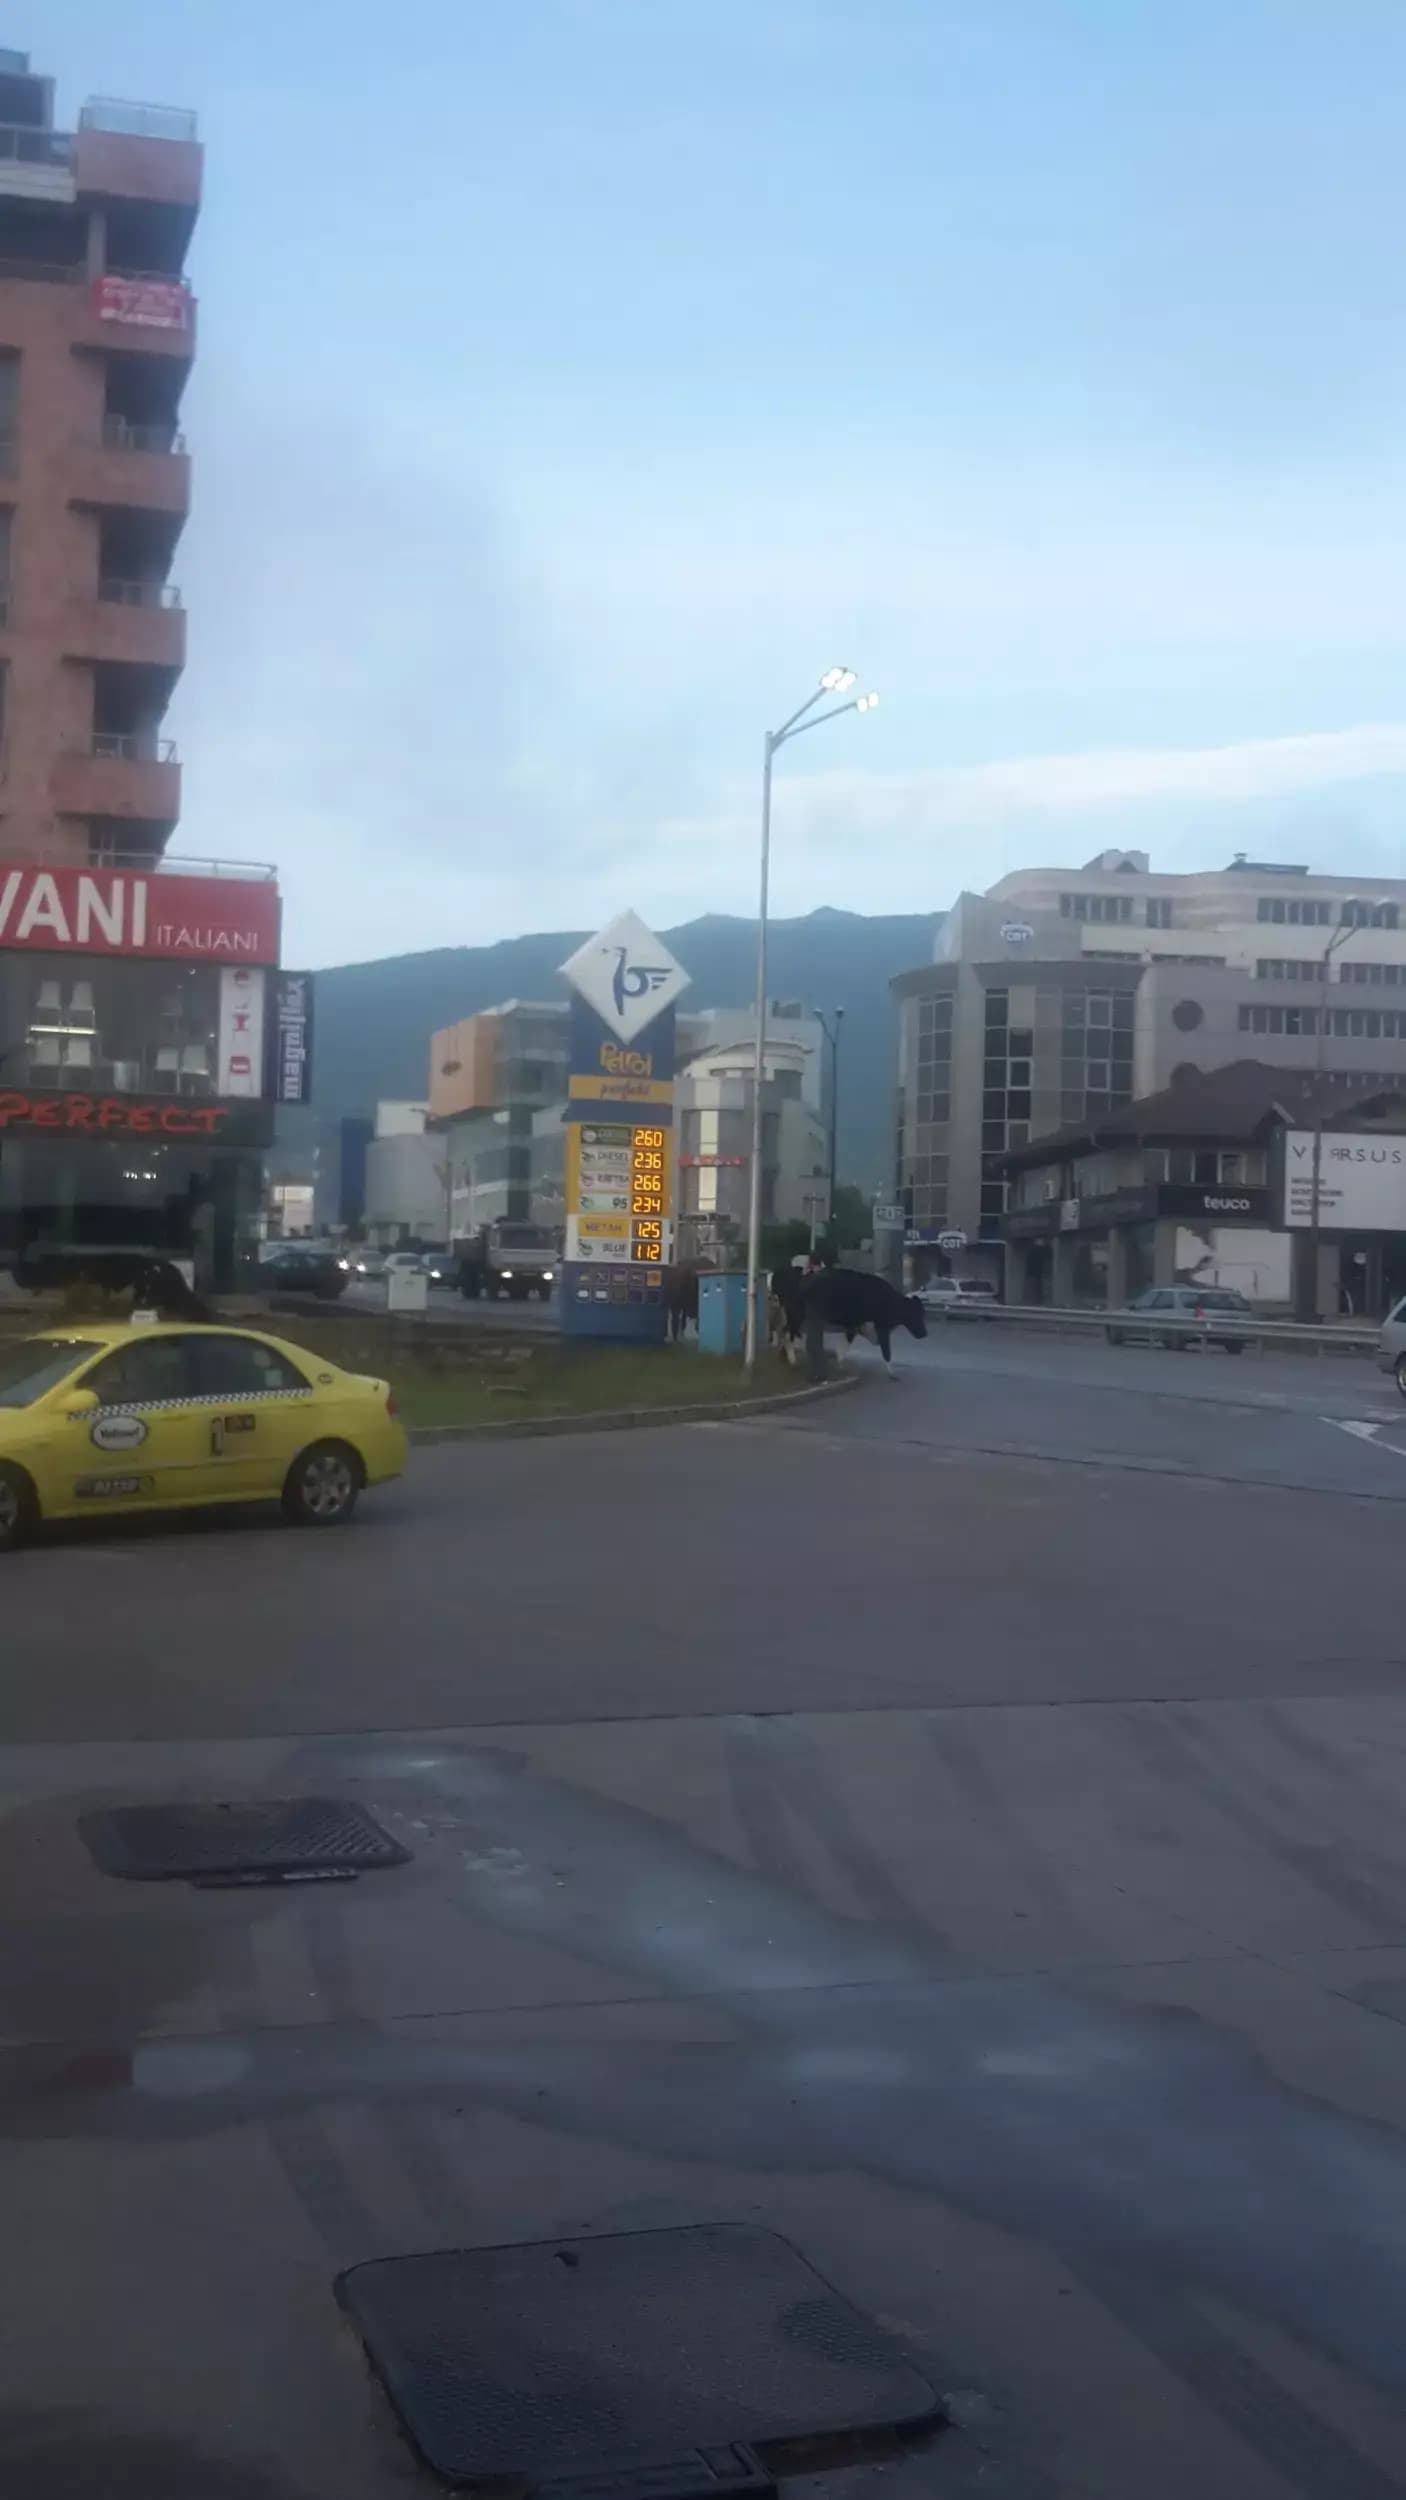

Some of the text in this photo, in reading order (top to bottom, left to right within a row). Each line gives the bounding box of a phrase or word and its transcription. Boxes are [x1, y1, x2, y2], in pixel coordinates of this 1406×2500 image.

[157, 925, 259, 951] ITALIANI
[0, 1092, 229, 1135] PERFECT
[1292, 1145, 1402, 1164] VRSUS
[1204, 1195, 1251, 1211] teuco
